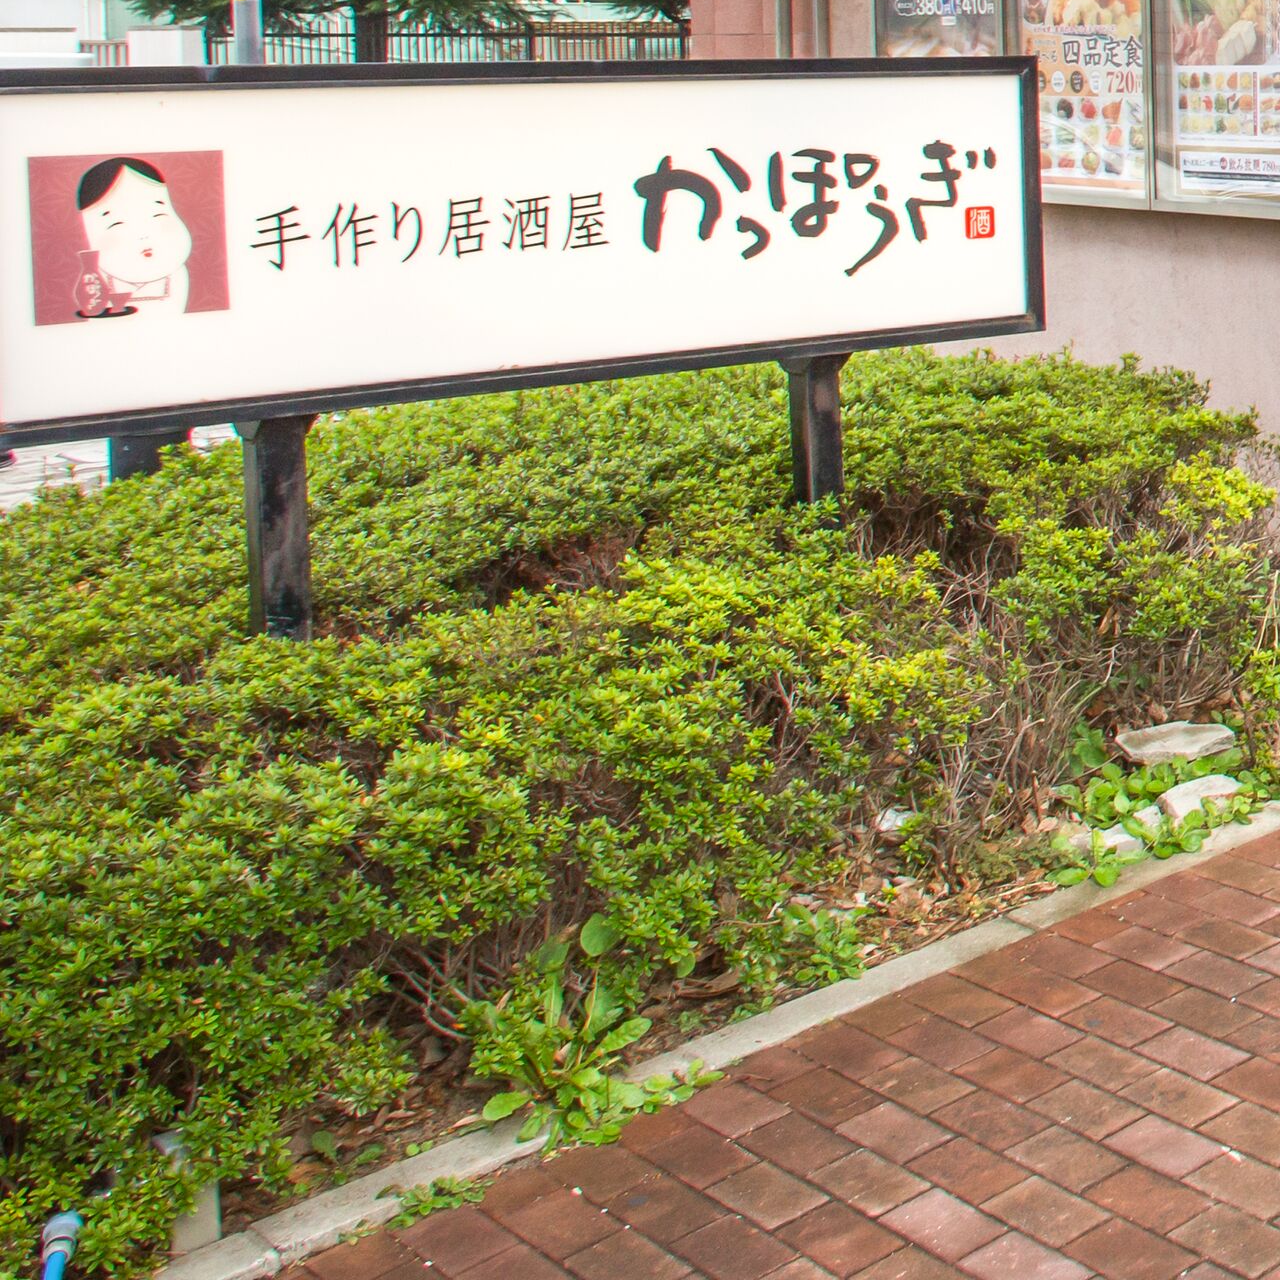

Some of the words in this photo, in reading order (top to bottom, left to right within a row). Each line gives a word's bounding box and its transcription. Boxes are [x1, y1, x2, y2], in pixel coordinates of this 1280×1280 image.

[1062, 35, 1144, 69] 四品定食
[249, 191, 611, 272] 手作り居酒屋
[632, 138, 999, 279] かっぽうぎ
